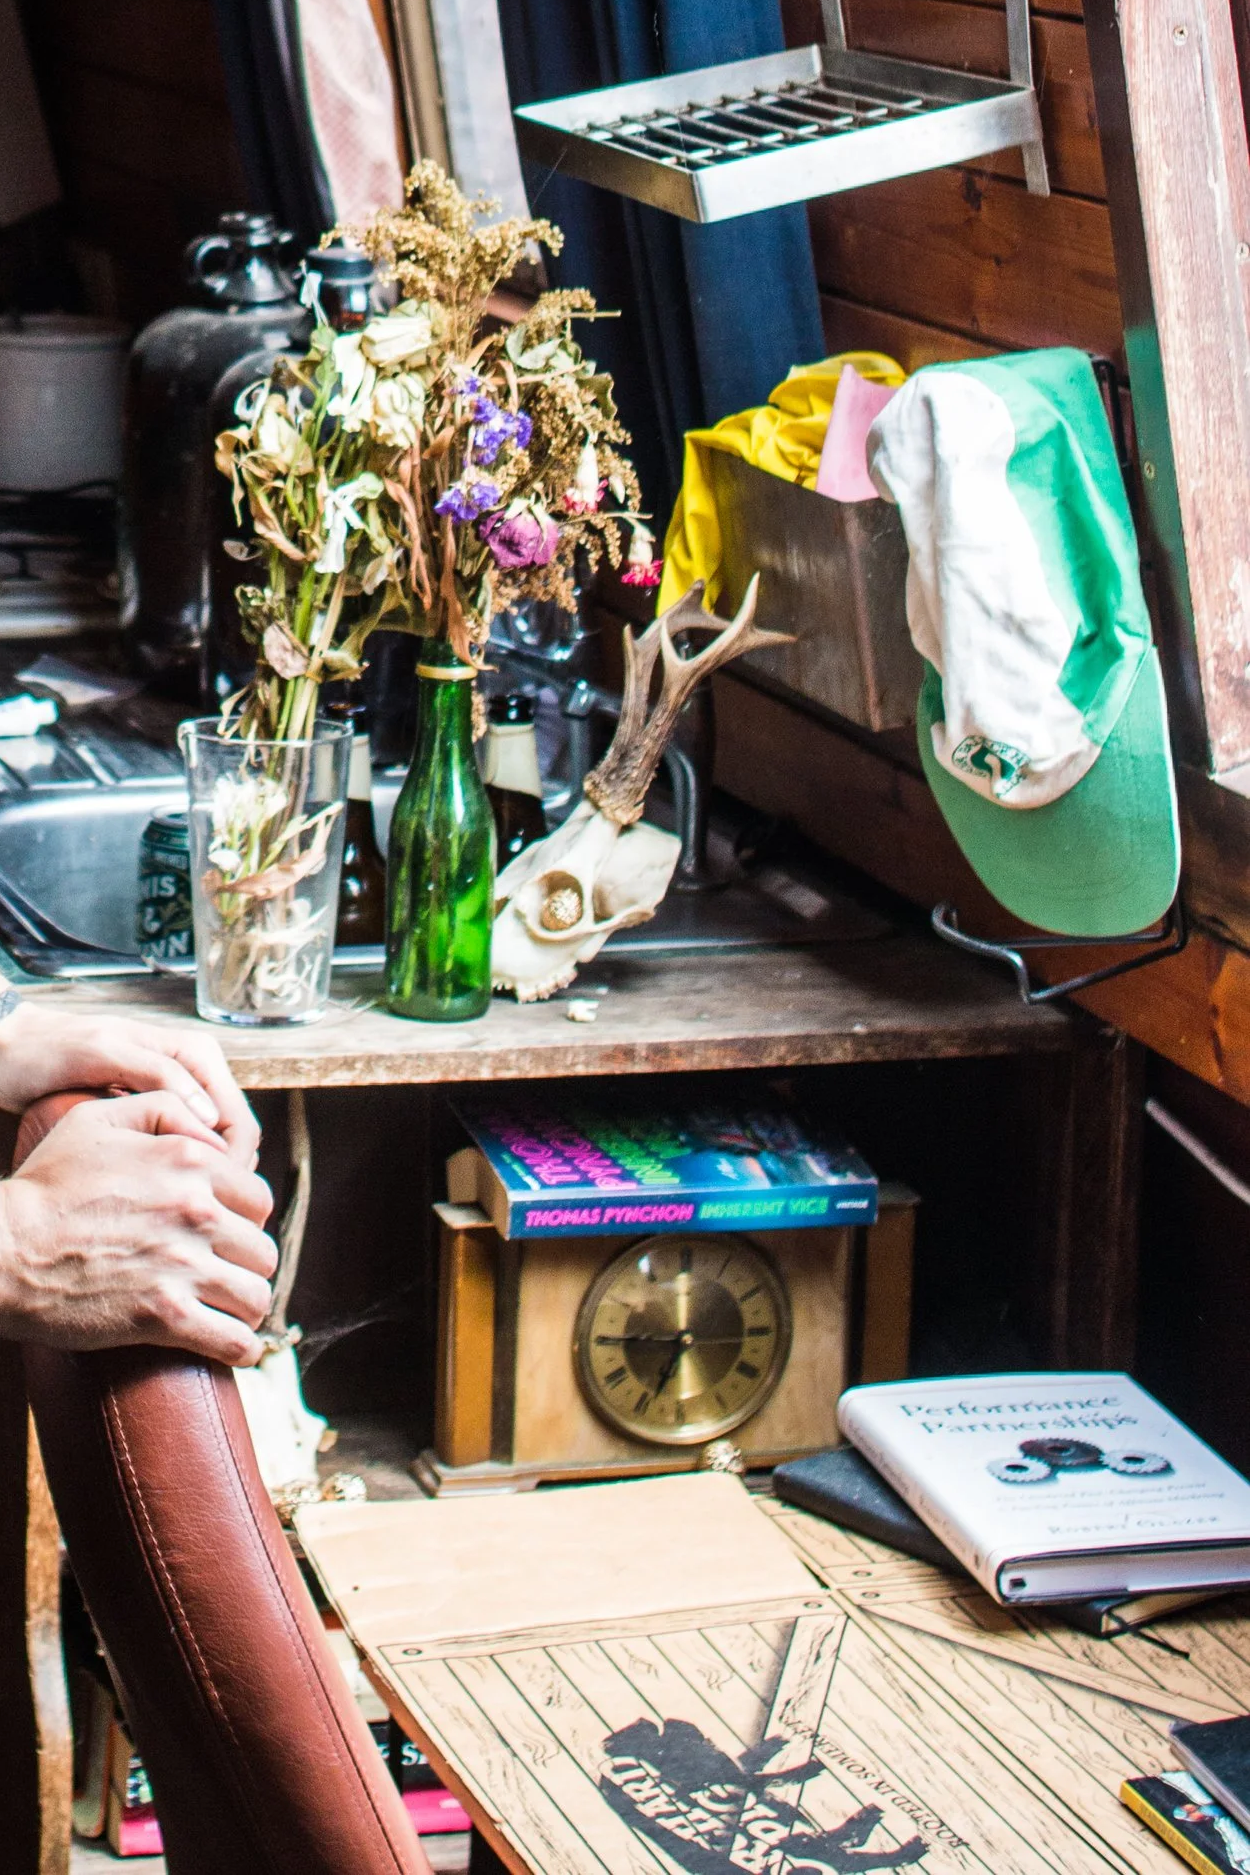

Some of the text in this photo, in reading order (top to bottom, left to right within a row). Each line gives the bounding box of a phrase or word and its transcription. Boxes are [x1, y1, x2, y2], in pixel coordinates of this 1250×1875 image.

[525, 1197, 830, 1227] THOMAS PYNCHON INHERENT VICE
[900, 1396, 1123, 1418] Performance
[921, 1412, 1139, 1434] Partnerships
[869, 1779, 895, 1796] IN
[690, 1783, 821, 1849] PIG
[891, 1796, 969, 1848] ROOTED
